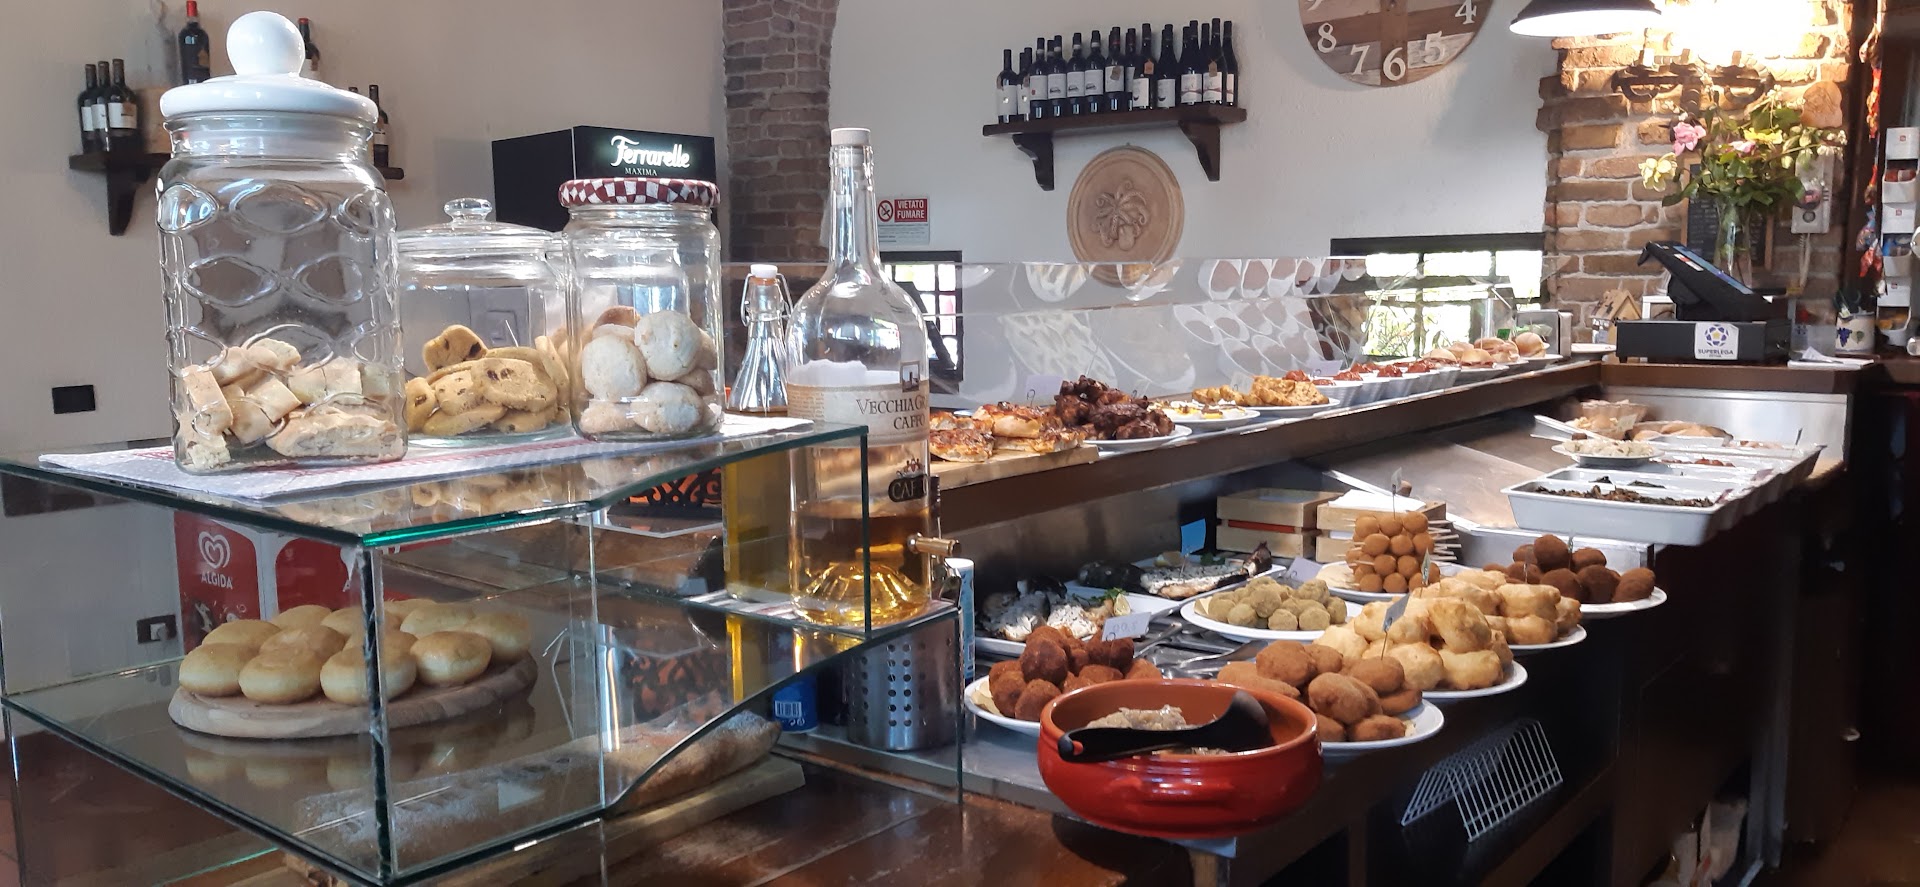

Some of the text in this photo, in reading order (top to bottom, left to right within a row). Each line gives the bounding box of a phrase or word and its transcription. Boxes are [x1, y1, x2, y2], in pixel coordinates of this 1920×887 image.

[1455, 0, 1476, 24] 4
[1317, 23, 1337, 53] 8
[1424, 31, 1446, 63] 5
[1350, 44, 1370, 75] 7
[1383, 47, 1406, 81] 6
[610, 135, 690, 168] Ferrarelle
[624, 167, 658, 176] MAXIMA
[897, 200, 924, 209] VIETATO
[897, 210, 925, 219] FUMARE
[856, 399, 914, 414] VECCHIA
[892, 478, 928, 500] CAFO
[201, 571, 232, 590] ALGIDA
